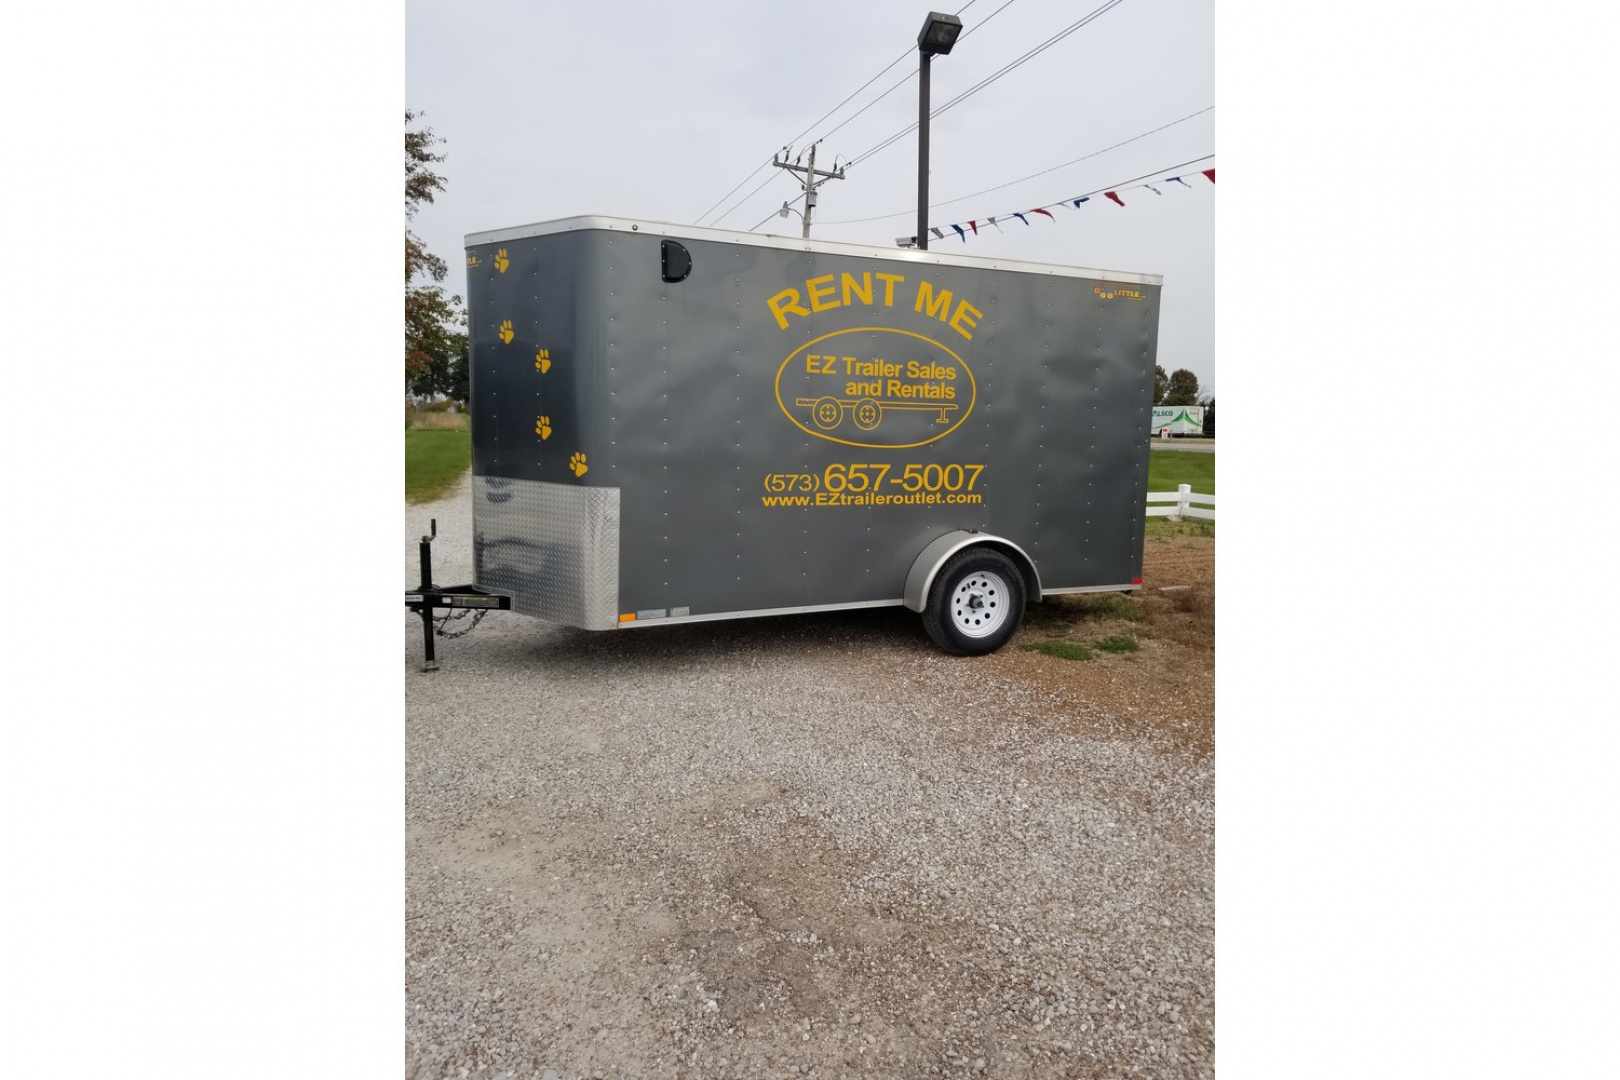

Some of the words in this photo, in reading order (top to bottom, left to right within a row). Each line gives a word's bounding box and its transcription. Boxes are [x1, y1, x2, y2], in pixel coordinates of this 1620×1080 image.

[766, 271, 905, 331] RENT
[914, 280, 984, 341] ME
[806, 355, 837, 375] EZ
[842, 357, 903, 378] Trailer
[906, 360, 957, 380] Sales
[845, 379, 881, 397] and
[887, 380, 956, 400] Rentals
[764, 472, 820, 493] (573)
[824, 463, 985, 493] 657-5007
[762, 491, 982, 506] www.EZtraileroutlet.com
